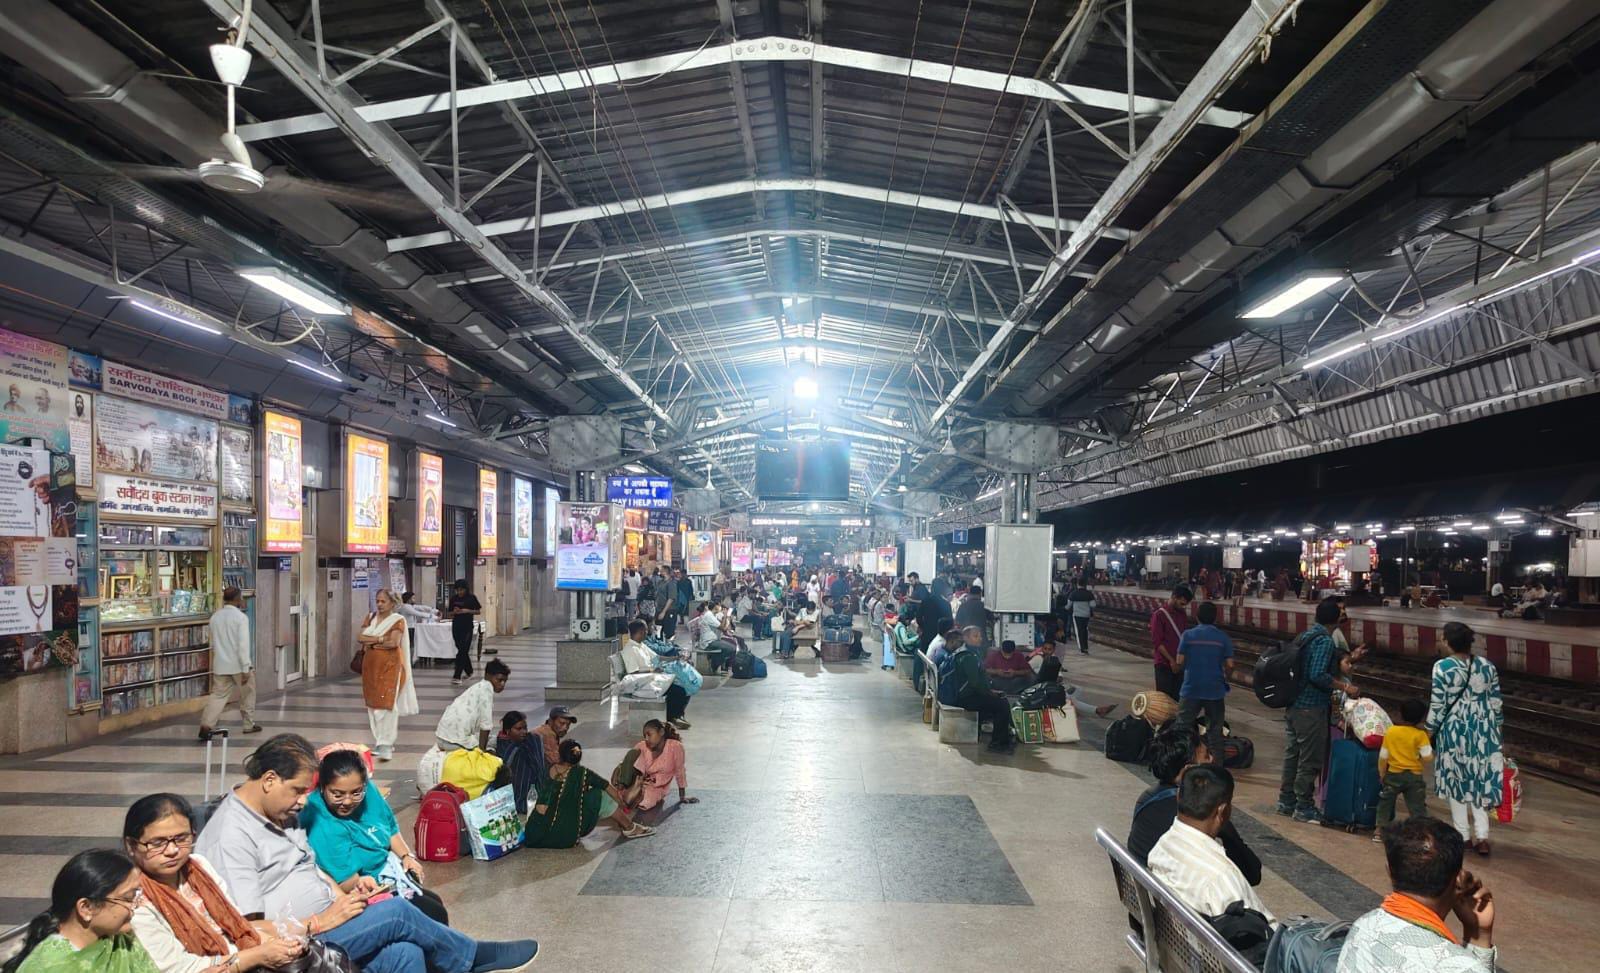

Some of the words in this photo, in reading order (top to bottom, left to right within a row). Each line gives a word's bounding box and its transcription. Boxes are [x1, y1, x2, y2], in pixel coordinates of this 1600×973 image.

[108, 366, 152, 385] सर्वोदय
[109, 377, 169, 398] SARVODAYA
[172, 392, 198, 405] BOOK
[200, 400, 225, 412] STALL
[117, 485, 149, 501] सर्वोदय
[152, 490, 168, 504] बुक
[169, 492, 192, 504] स्टाल
[633, 498, 651, 507] HELP
[652, 498, 668, 507] YOU
